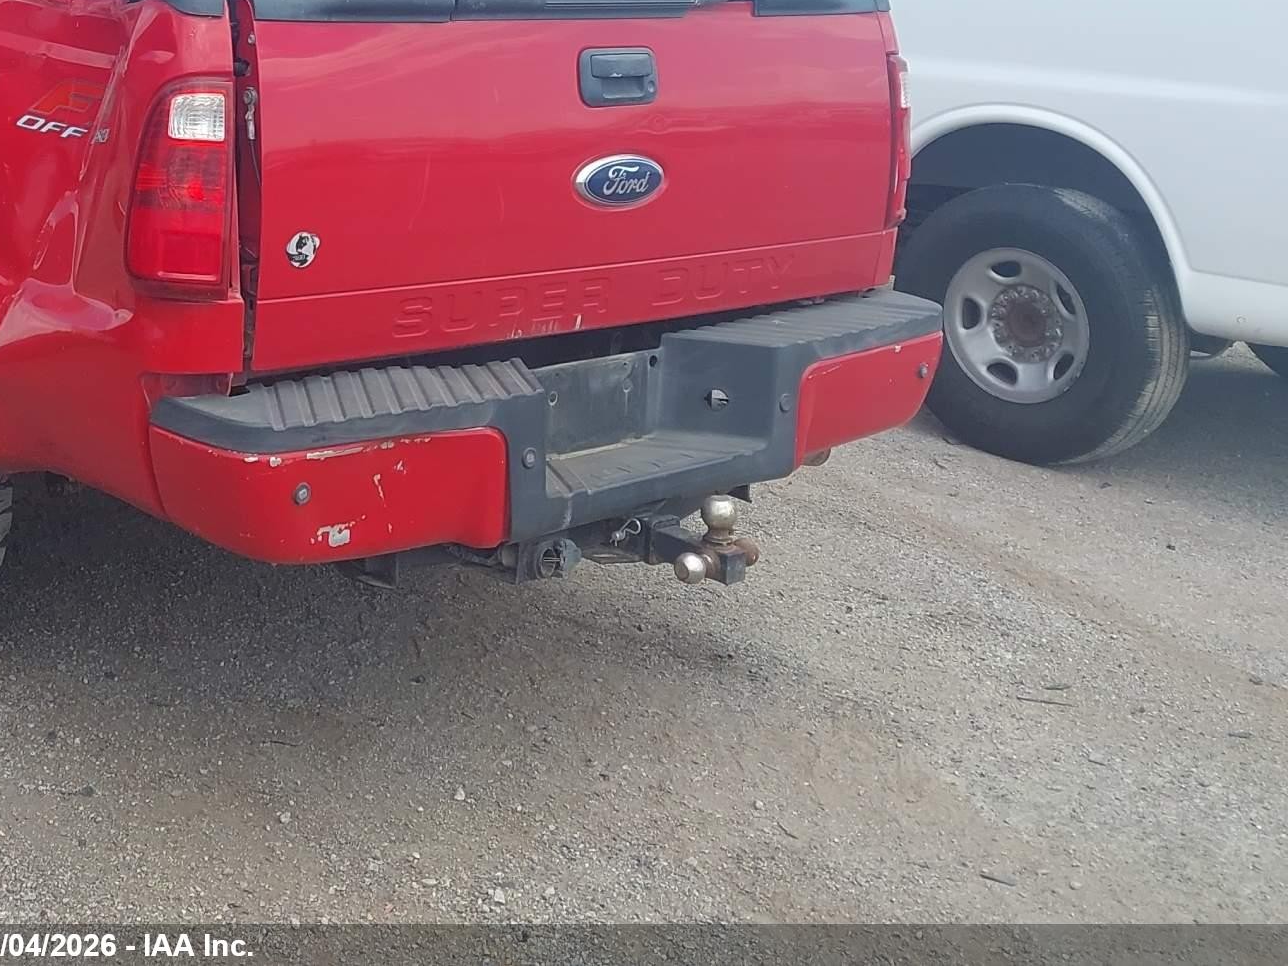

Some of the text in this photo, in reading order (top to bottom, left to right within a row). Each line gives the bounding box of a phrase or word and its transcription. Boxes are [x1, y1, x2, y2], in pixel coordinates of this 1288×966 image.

[15, 114, 89, 138] OFF
[603, 165, 651, 196] Ford
[392, 252, 797, 338] SUPER DUTY
